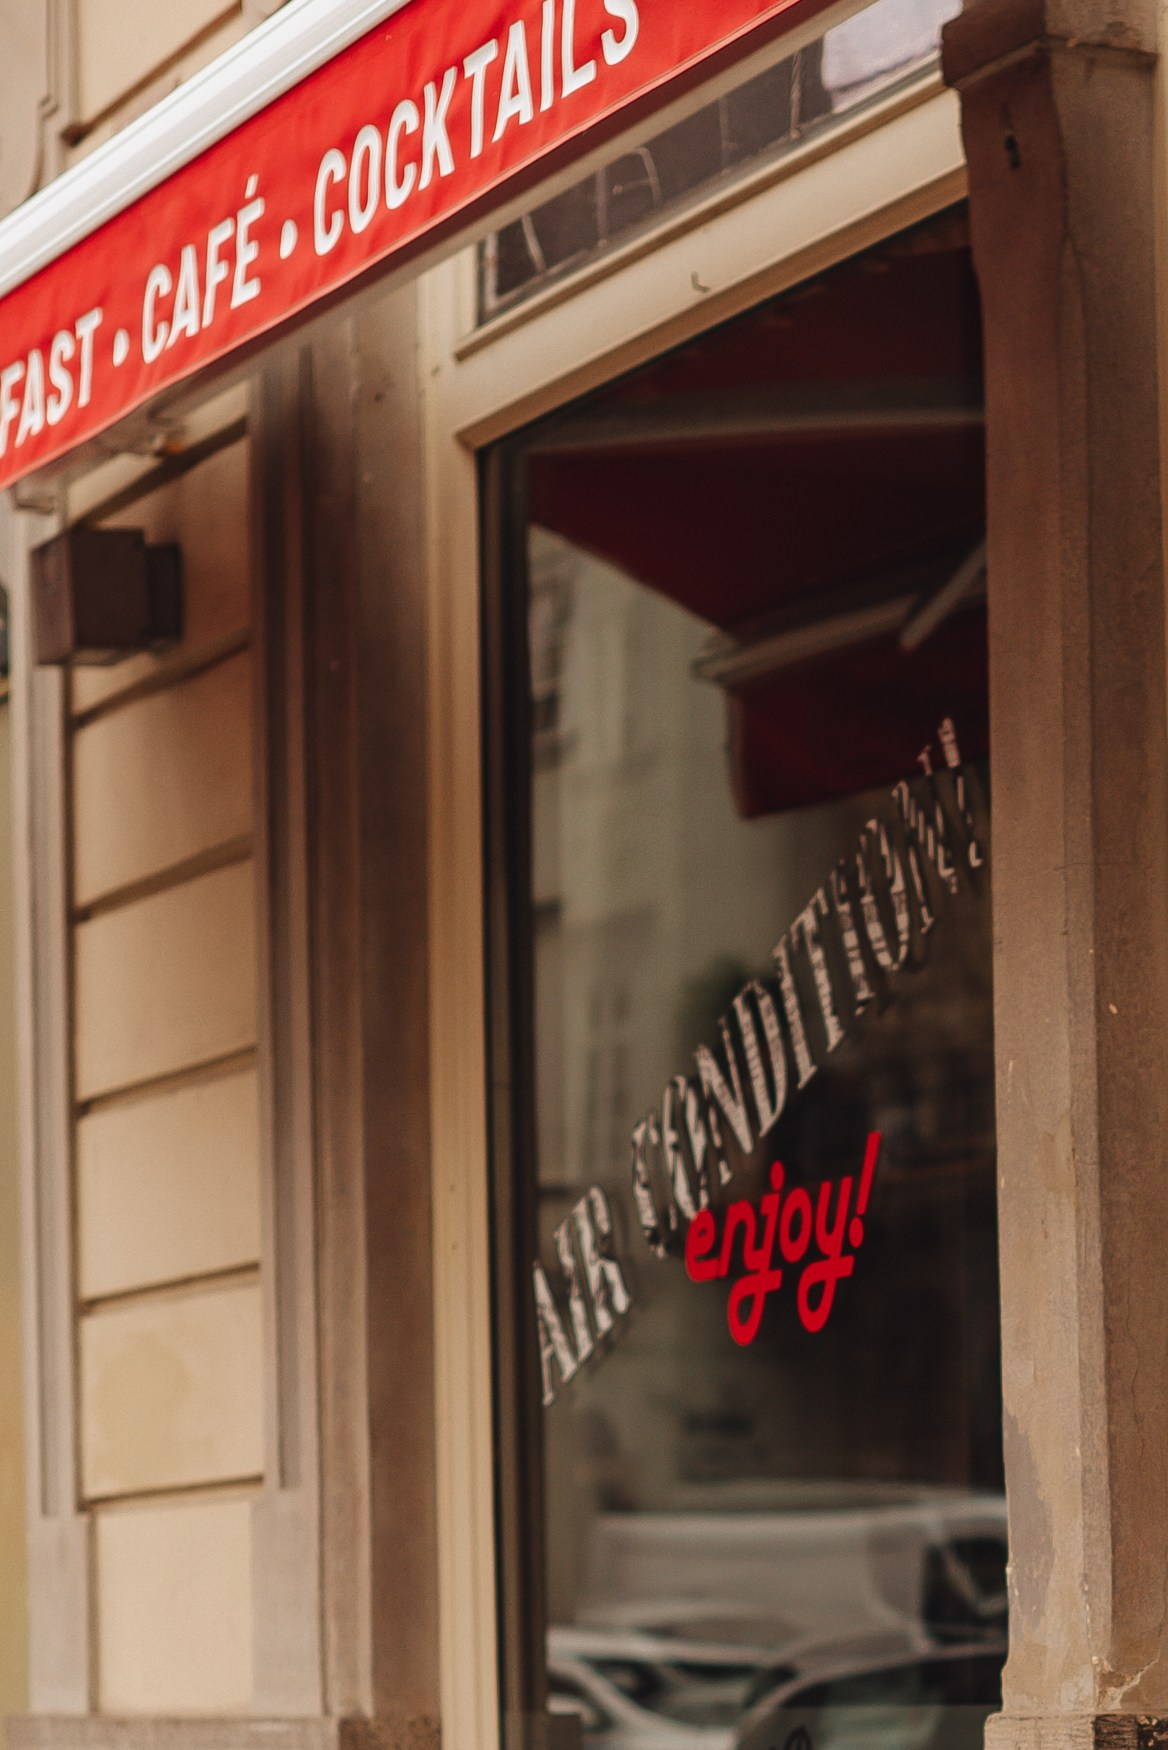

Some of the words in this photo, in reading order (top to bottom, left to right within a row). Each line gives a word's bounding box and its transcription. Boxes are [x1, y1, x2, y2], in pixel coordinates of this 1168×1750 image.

[0, 306, 103, 460] FAST
[142, 174, 265, 364] CAFÉ
[313, 0, 640, 256] COCKTAILS
[532, 1185, 631, 1406] AIR
[685, 1131, 882, 1346] enjoy!
